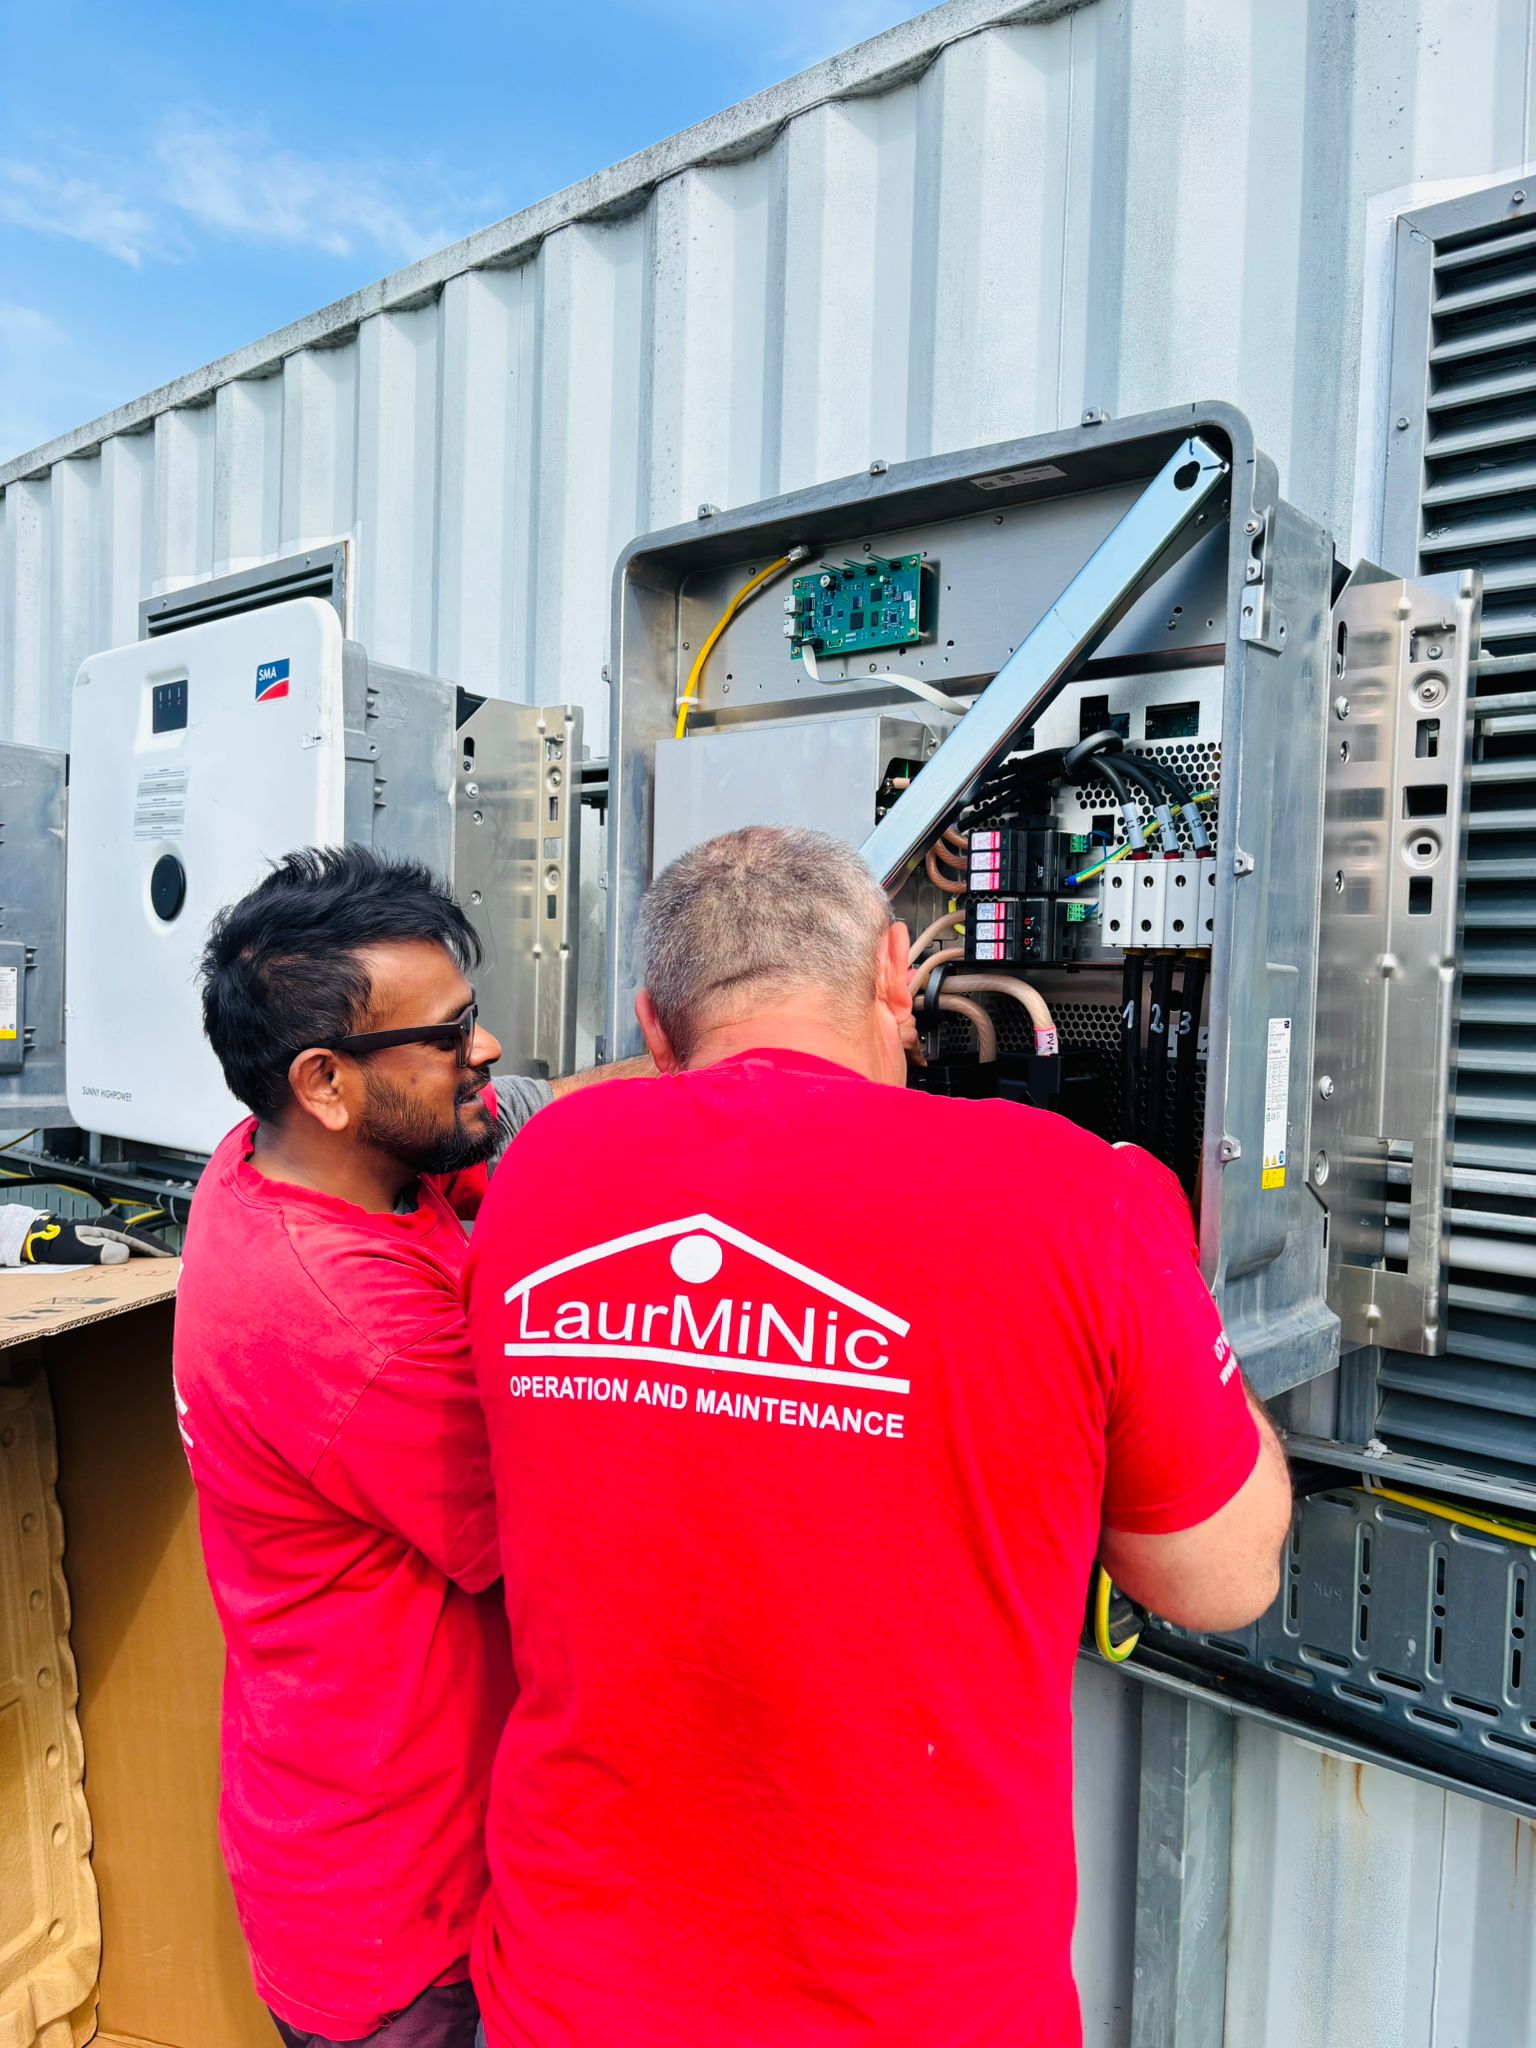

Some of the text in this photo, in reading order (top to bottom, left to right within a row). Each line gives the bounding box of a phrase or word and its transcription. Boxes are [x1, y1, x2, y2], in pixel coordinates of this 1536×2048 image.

[258, 666, 277, 681] SMA
[1122, 1000, 1135, 1029] 1
[1150, 1003, 1165, 1034] 2
[1179, 1011, 1192, 1035] 3
[518, 1289, 890, 1371] LaurMiNic
[510, 1375, 904, 1439] OPERATION AND MAINTENANCE
